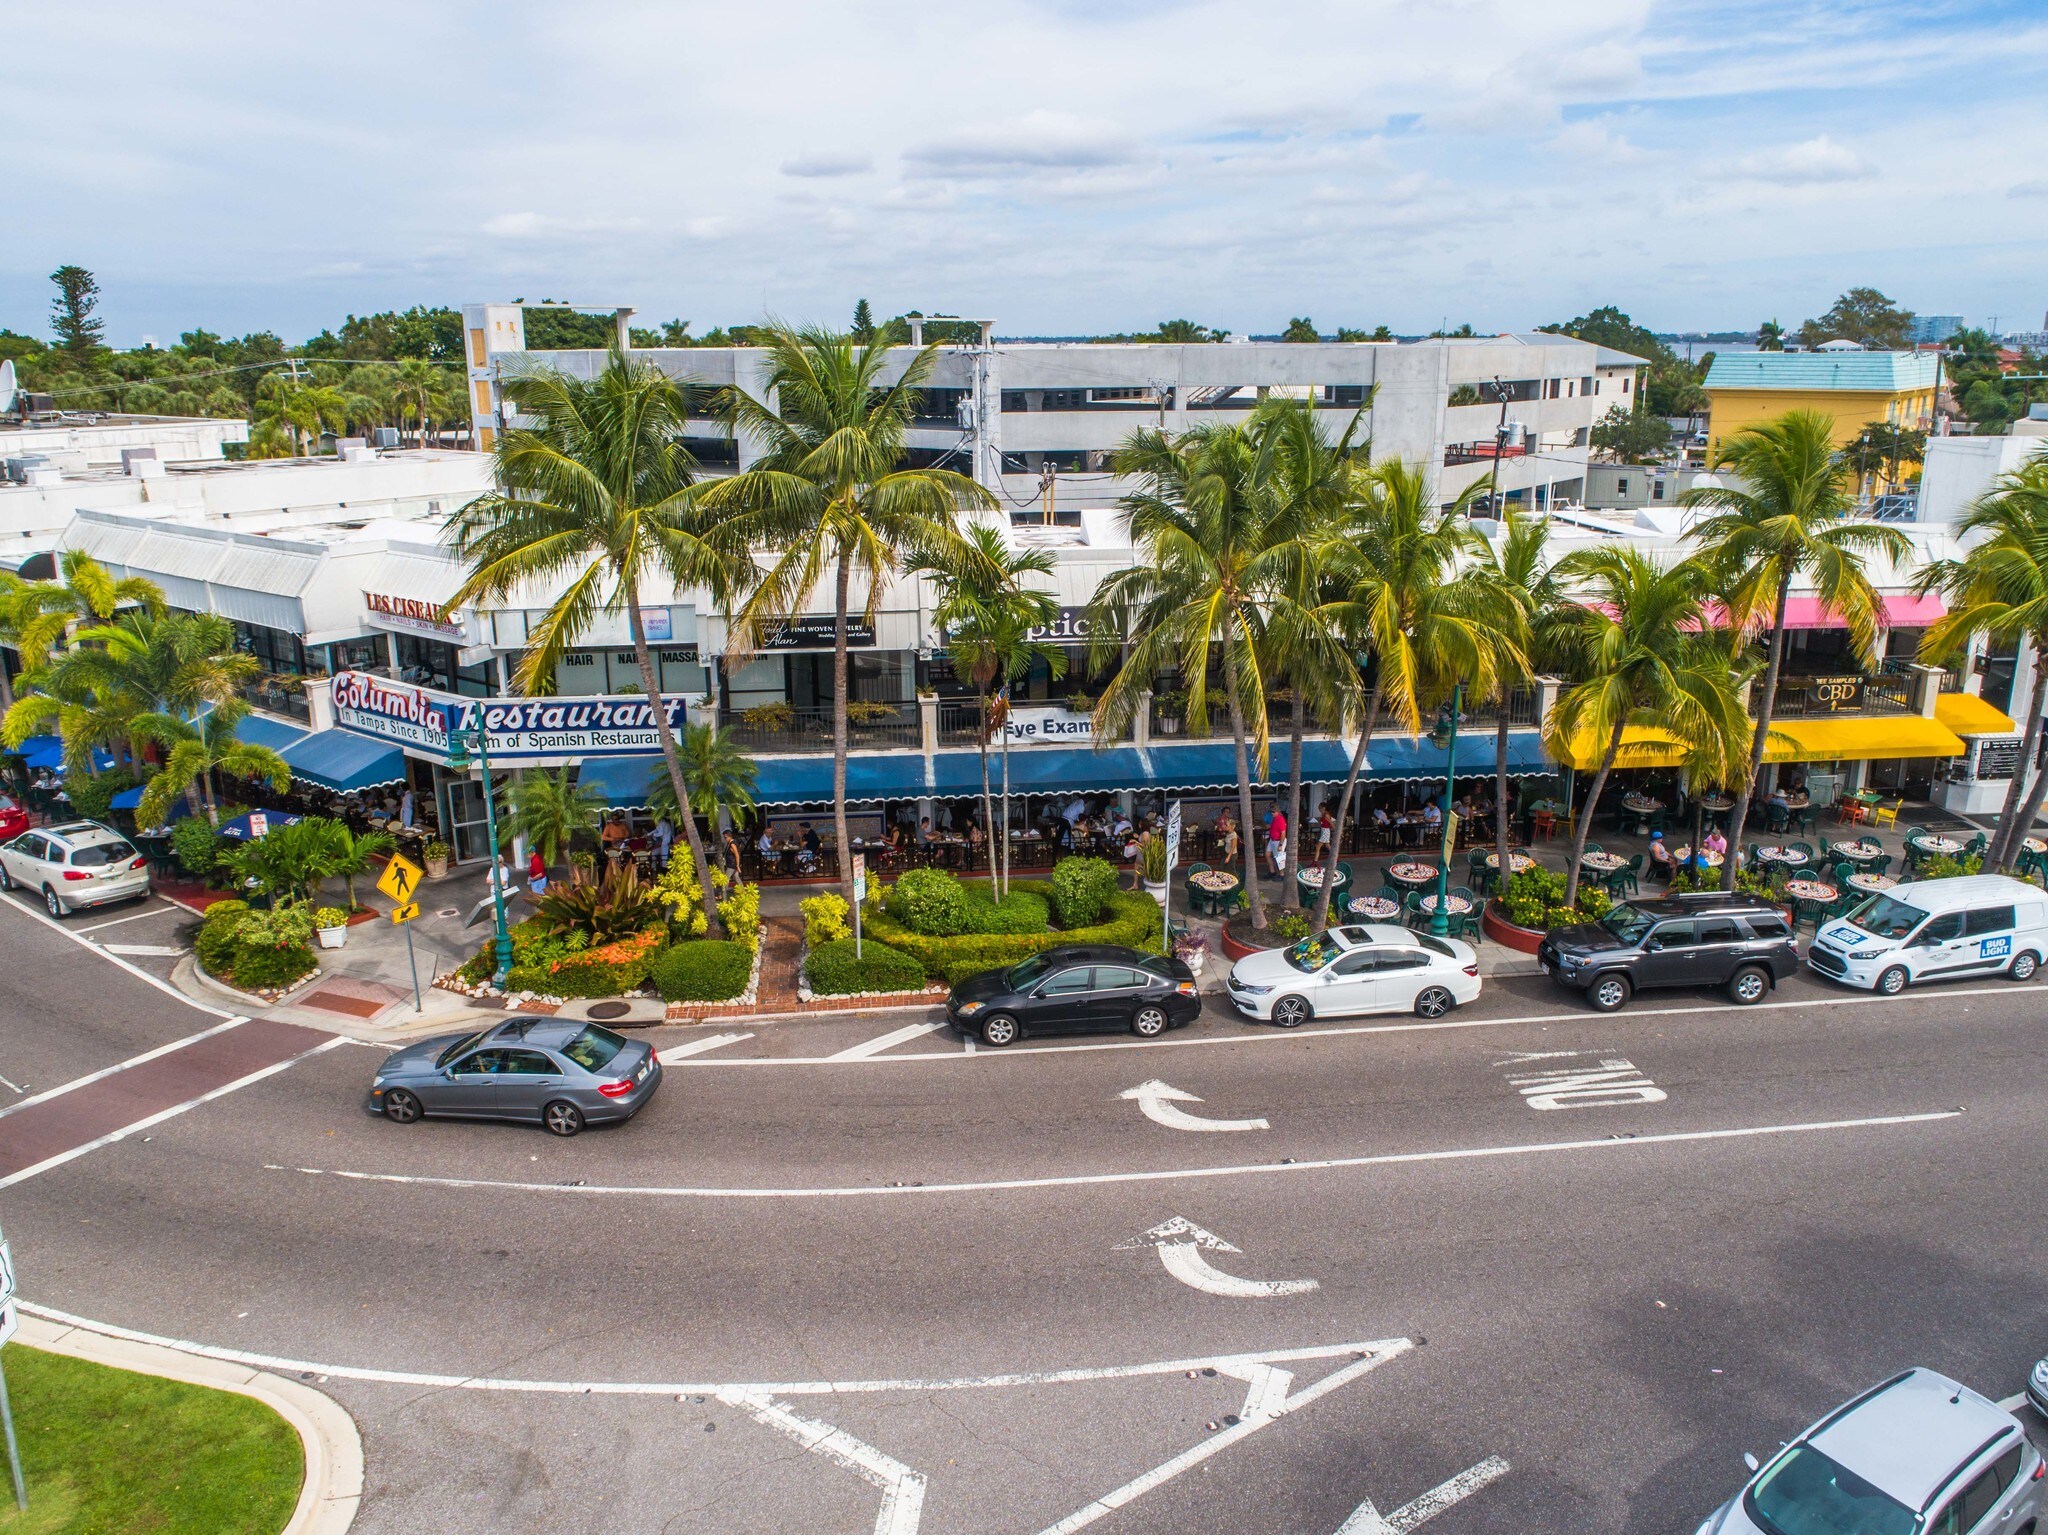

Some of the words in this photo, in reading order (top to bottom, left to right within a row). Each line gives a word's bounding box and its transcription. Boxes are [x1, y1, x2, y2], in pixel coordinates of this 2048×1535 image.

[366, 593, 391, 613] LES
[416, 620, 428, 630] SKIN
[764, 633, 798, 646] Alan
[566, 654, 594, 666] HAIR
[1817, 684, 1856, 701] CBD
[332, 670, 446, 734] Columbia
[458, 697, 681, 731] Restaurant
[340, 708, 351, 721] In
[355, 710, 386, 731] Tampa
[389, 720, 418, 740] Since
[422, 728, 448, 747] 1905
[1006, 721, 1037, 738] Eye
[506, 734, 520, 747] of
[528, 732, 585, 750] Spanish
[590, 731, 676, 745] Restaurans
[1772, 752, 1790, 761] BAR
[1803, 750, 1825, 760] GRILL
[1981, 945, 2009, 957] LIGHT
[1986, 938, 2006, 949] BUD
